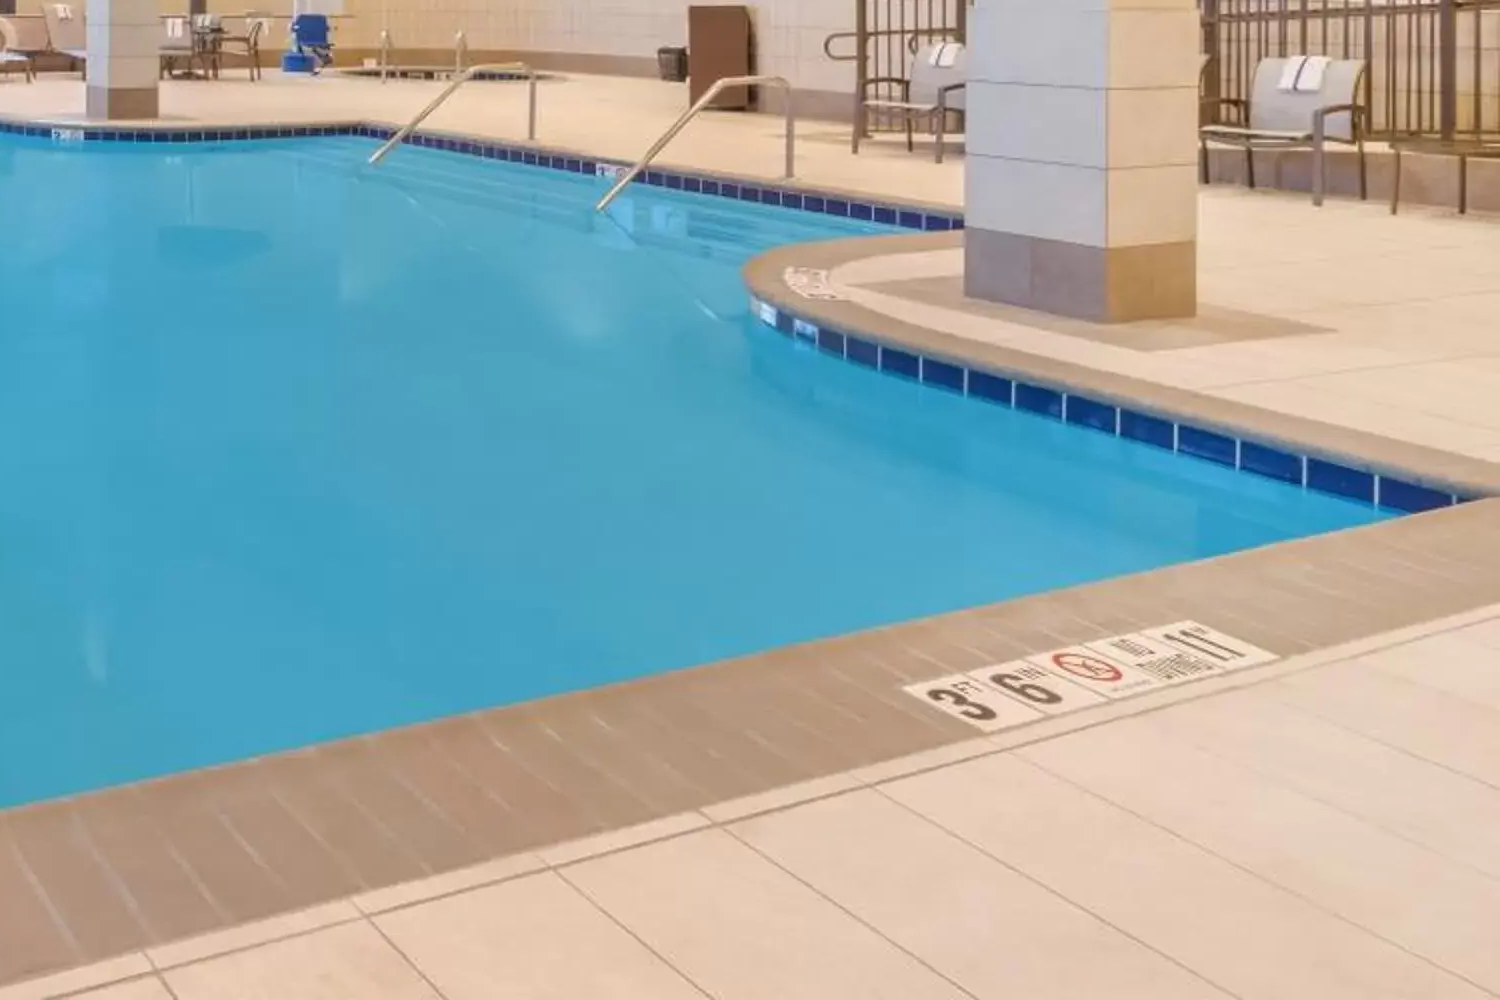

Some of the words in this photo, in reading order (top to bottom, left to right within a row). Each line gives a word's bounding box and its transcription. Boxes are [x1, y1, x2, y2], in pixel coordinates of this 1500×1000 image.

[951, 681, 983, 695] FT
[989, 673, 1063, 704] 6
[927, 689, 997, 720] 3
